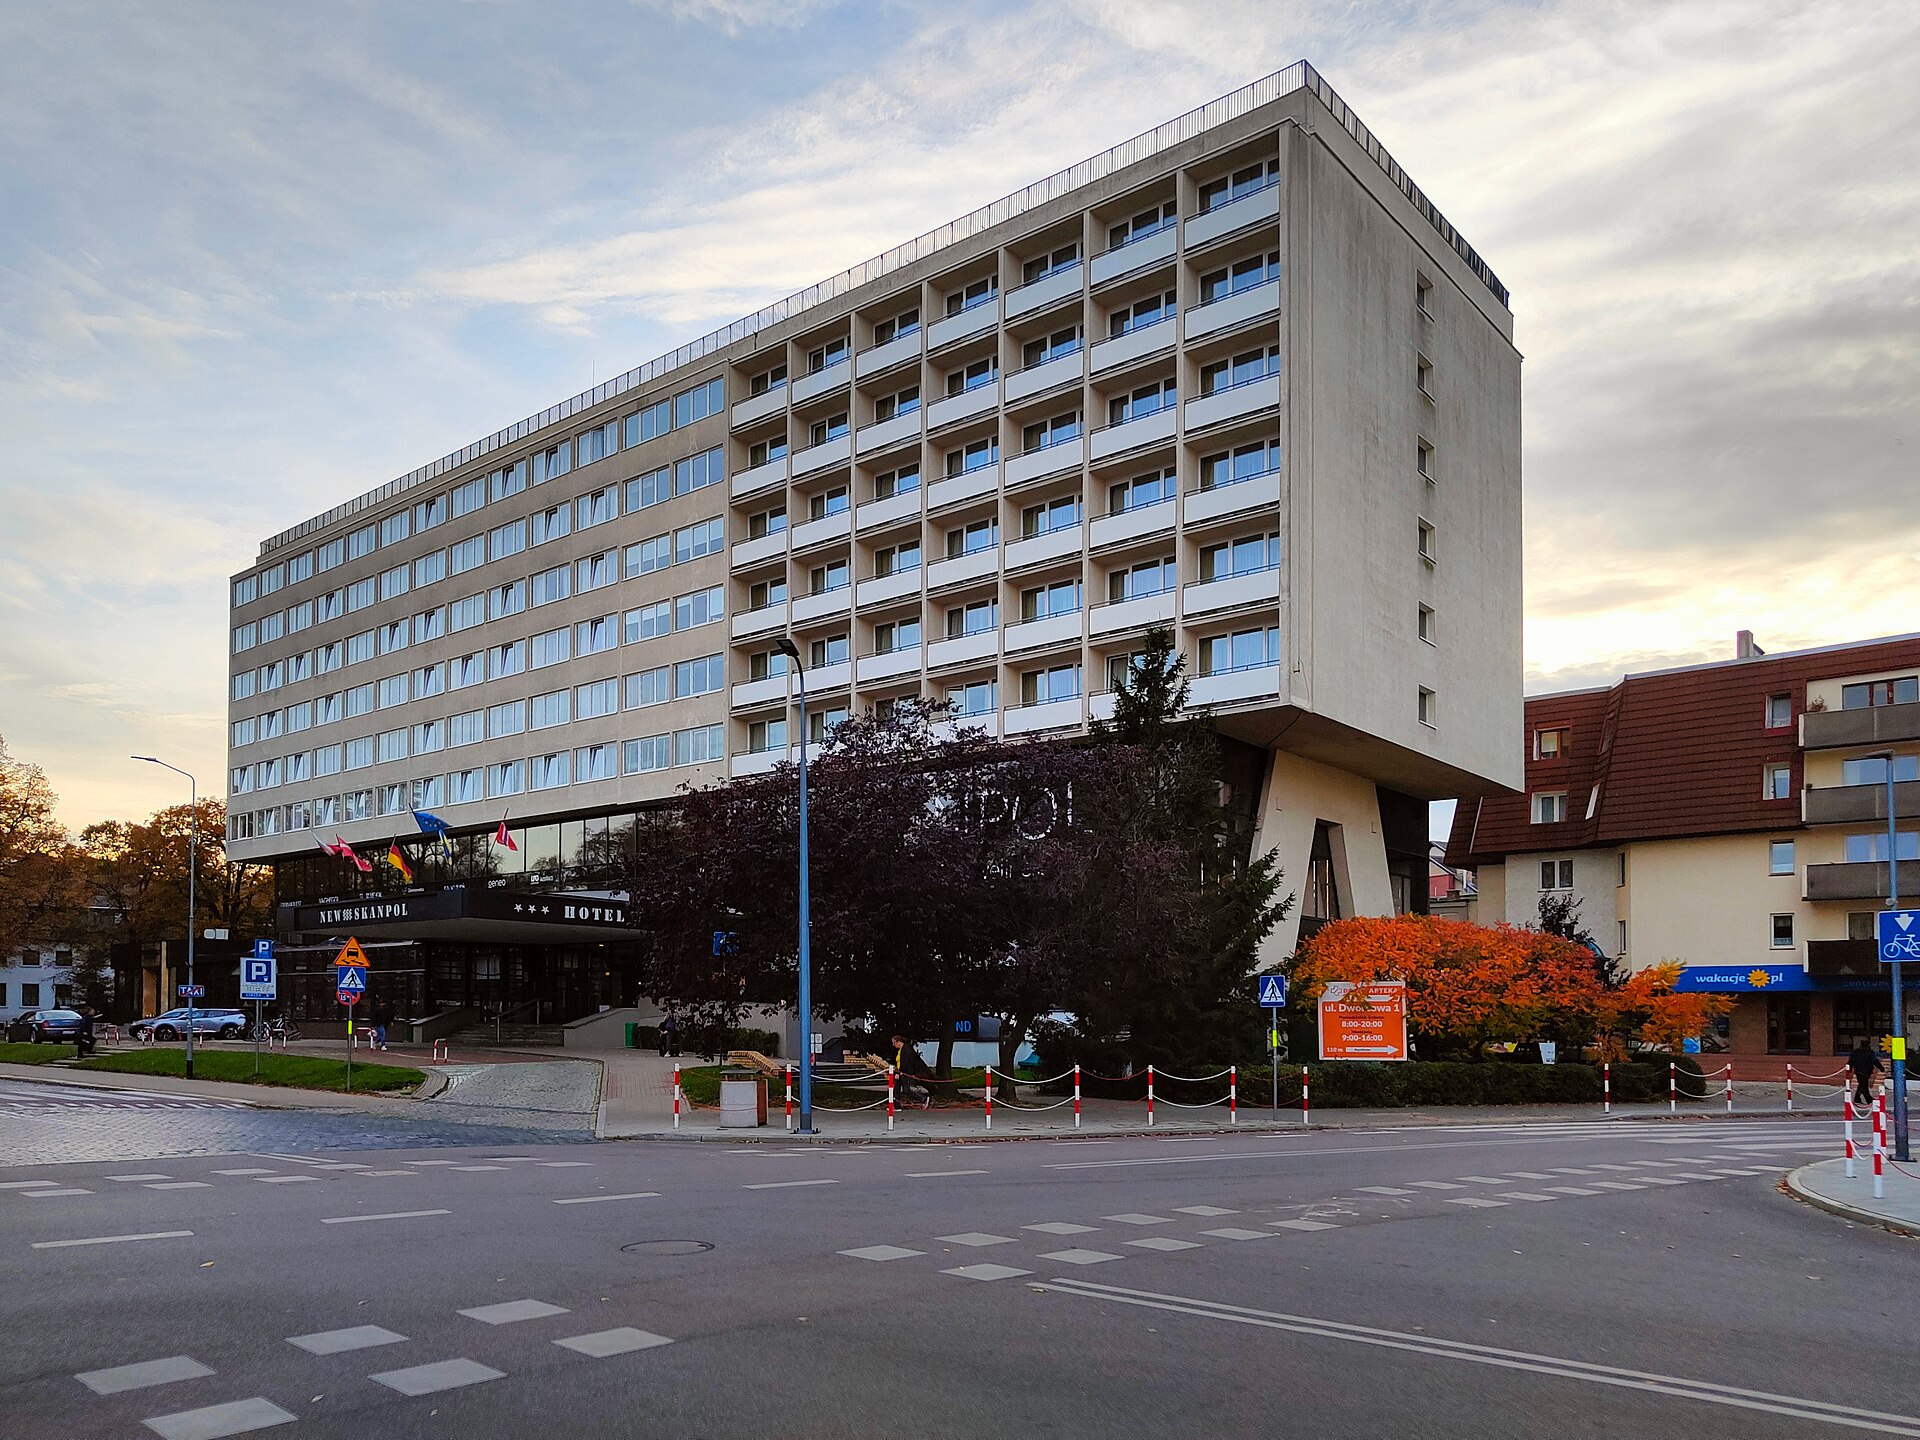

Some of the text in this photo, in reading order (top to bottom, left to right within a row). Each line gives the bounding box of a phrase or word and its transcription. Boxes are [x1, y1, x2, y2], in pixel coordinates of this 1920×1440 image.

[319, 909, 342, 924] NEW
[354, 898, 408, 921] SKANPOL
[564, 905, 625, 923] HOTEL
[258, 941, 270, 953] P
[251, 962, 267, 980] P
[1695, 973, 1746, 985] wakacje
[180, 986, 203, 996] TAXI
[1324, 1003, 1337, 1012] ul.
[1393, 1003, 1400, 1012] 1
[1341, 1020, 1383, 1028] 8:00-20:00
[1341, 1034, 1383, 1042] 9:00-16:00
